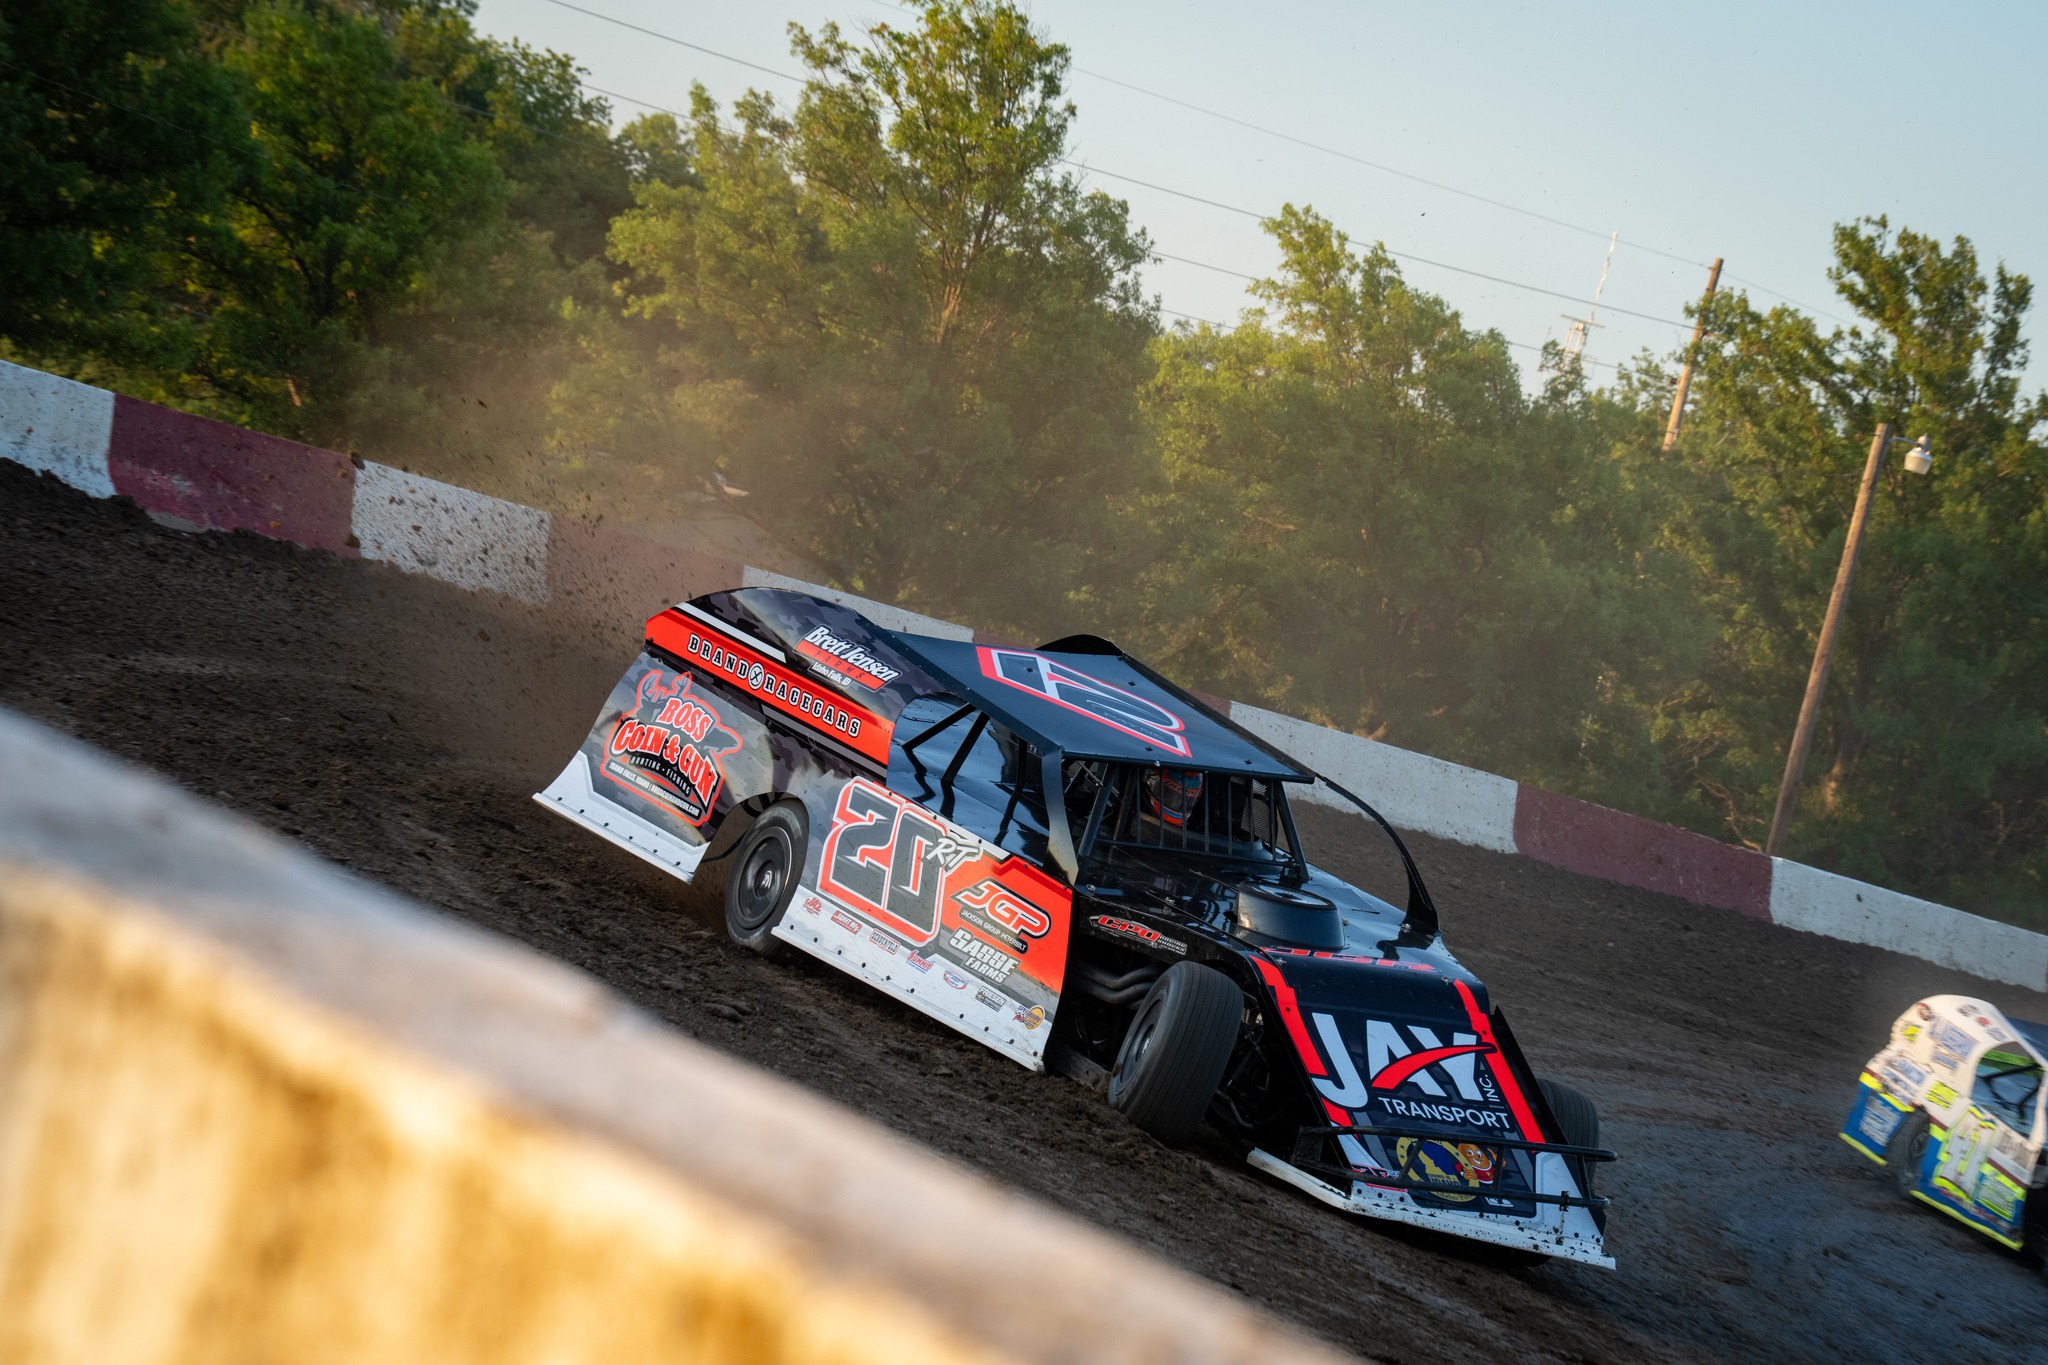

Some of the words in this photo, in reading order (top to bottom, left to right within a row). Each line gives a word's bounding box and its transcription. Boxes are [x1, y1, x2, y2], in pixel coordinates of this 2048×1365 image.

[804, 626, 846, 657] Brett
[840, 644, 901, 682] Jensen
[811, 662, 830, 678] Idaho
[842, 677, 852, 687] ID
[814, 650, 864, 679] FARMS
[687, 633, 748, 680] BRAND
[763, 675, 862, 738] RACECARS
[656, 697, 714, 742] ROSS
[611, 719, 670, 756] COIN
[663, 734, 680, 764] &
[678, 744, 718, 807] GUN
[631, 757, 661, 772] HUNTING
[666, 768, 691, 795] FISHING
[825, 780, 949, 940] 20
[925, 837, 980, 871] RT
[956, 880, 1050, 936] JGP
[961, 910, 984, 925] JACKSON
[983, 922, 1001, 935] GROUP
[1000, 932, 1027, 951] PETERBILT
[949, 928, 1019, 975] SASSE
[965, 956, 1007, 983] FARMS
[978, 986, 1006, 1006] FRIESEN
[1312, 1012, 1484, 1108] JAY
[1478, 1073, 1501, 1102] INC.
[1378, 1097, 1511, 1129] TRANSPORT
